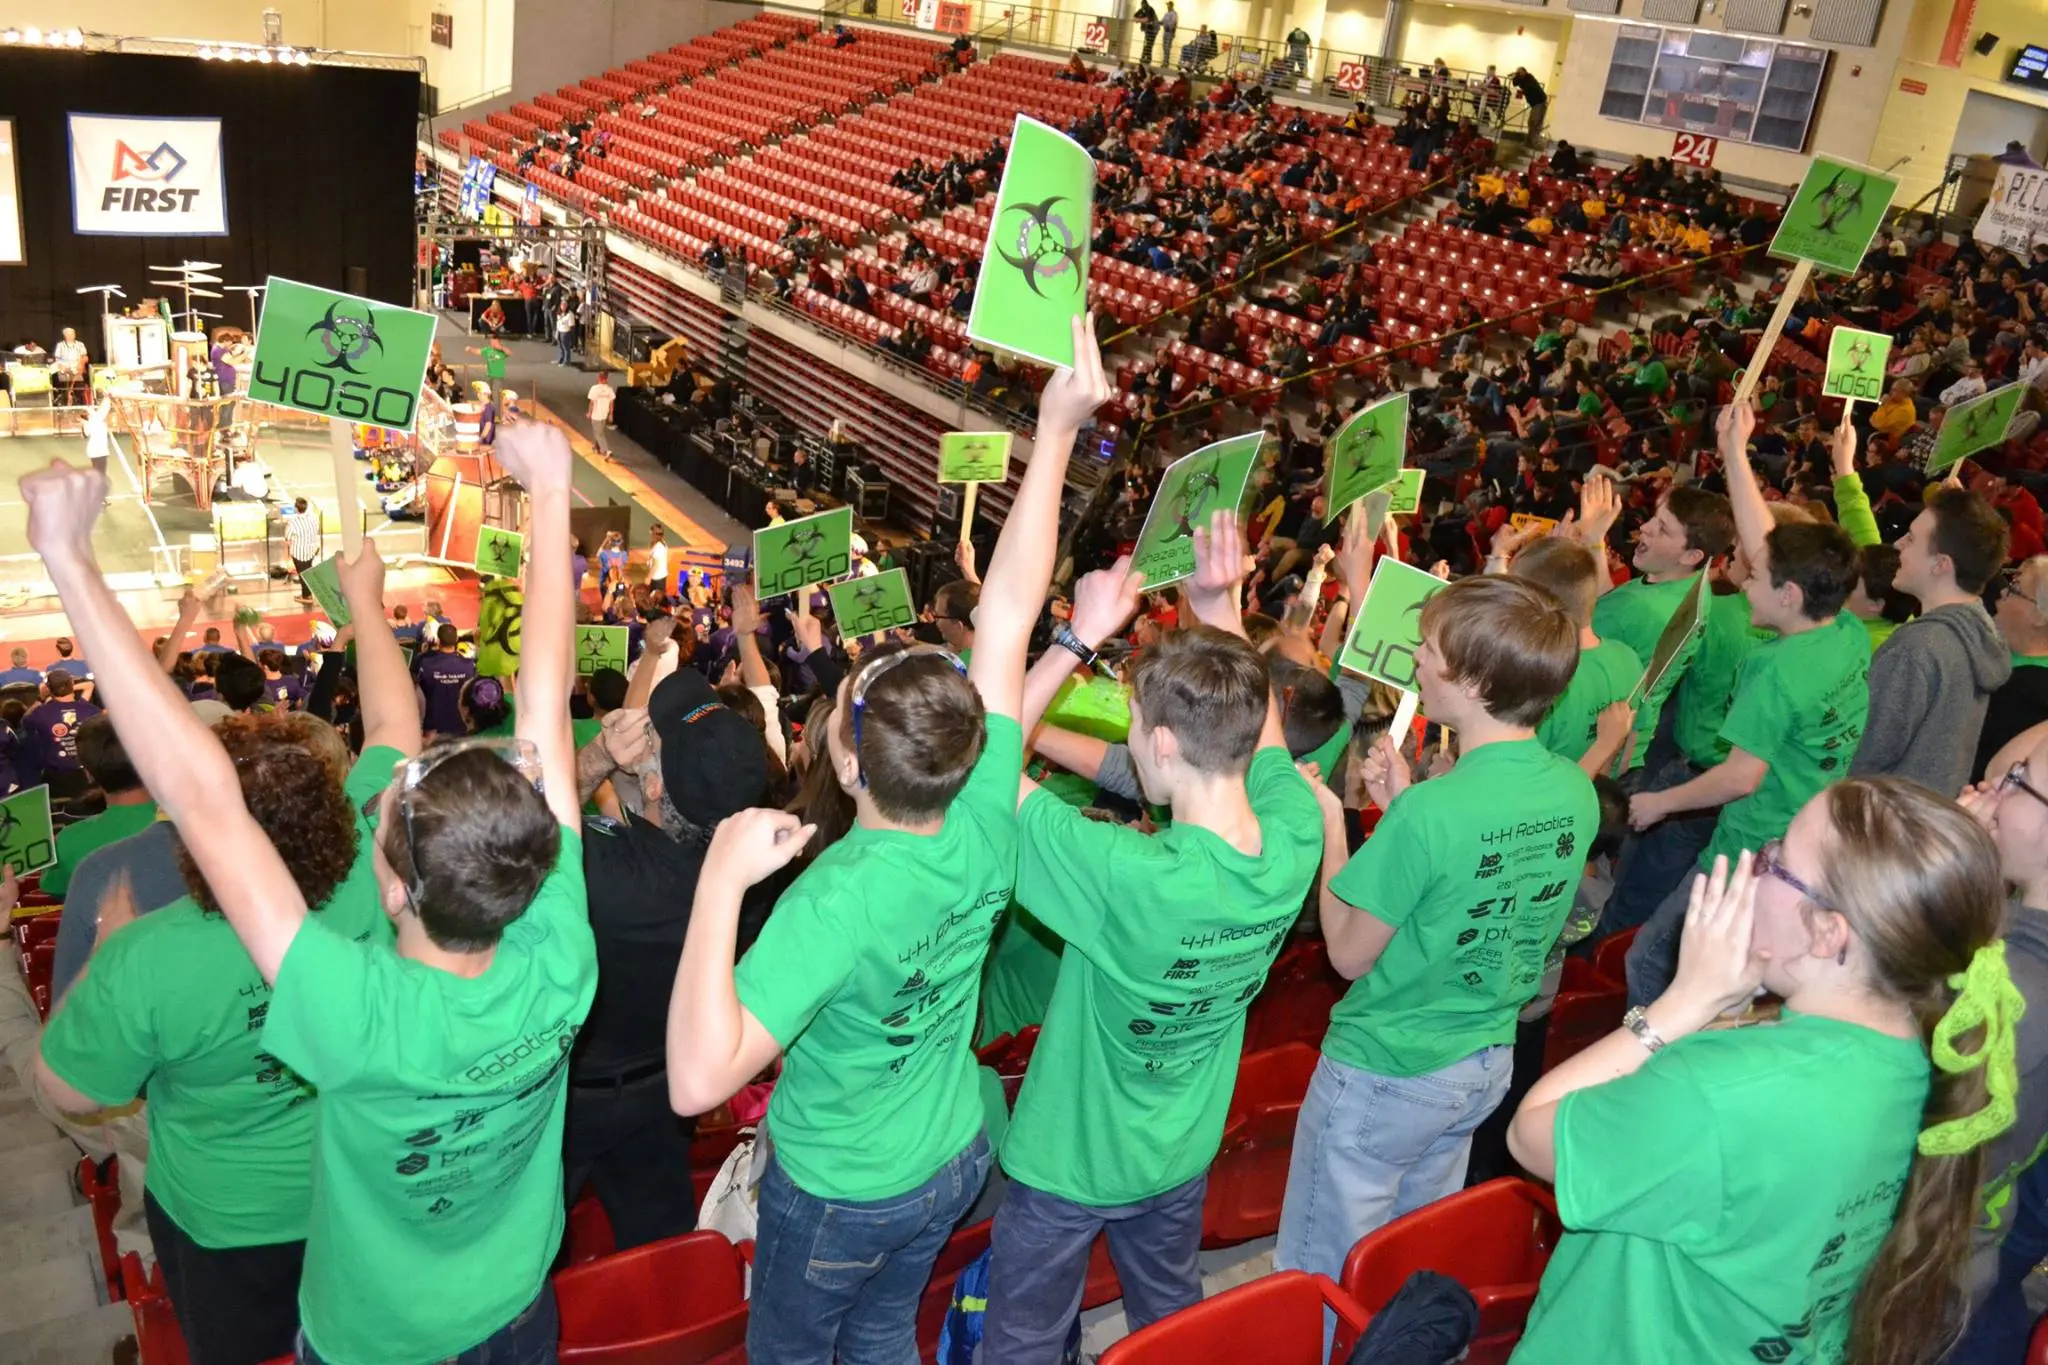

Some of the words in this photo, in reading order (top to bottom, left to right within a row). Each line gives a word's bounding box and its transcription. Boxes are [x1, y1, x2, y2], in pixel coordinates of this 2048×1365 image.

[1086, 24, 1106, 46] 22
[1338, 64, 1366, 90] 23
[1673, 134, 1712, 166] 24
[101, 187, 200, 212] FIRST
[255, 361, 415, 427] 4050
[1827, 373, 1881, 399] 4050
[724, 558, 745, 569] 3492
[759, 552, 849, 595] 4050
[840, 605, 913, 636] 4050
[578, 657, 626, 673] 050
[1351, 629, 1418, 687] 40
[1481, 826, 1513, 846] 4-H
[1515, 815, 1575, 840] Robotics
[1474, 865, 1505, 880] FIRST
[1181, 931, 1215, 950] 4-H
[1162, 970, 1201, 981] FIRST
[1185, 996, 1218, 1017] TE
[466, 1019, 568, 1084] Robotics
